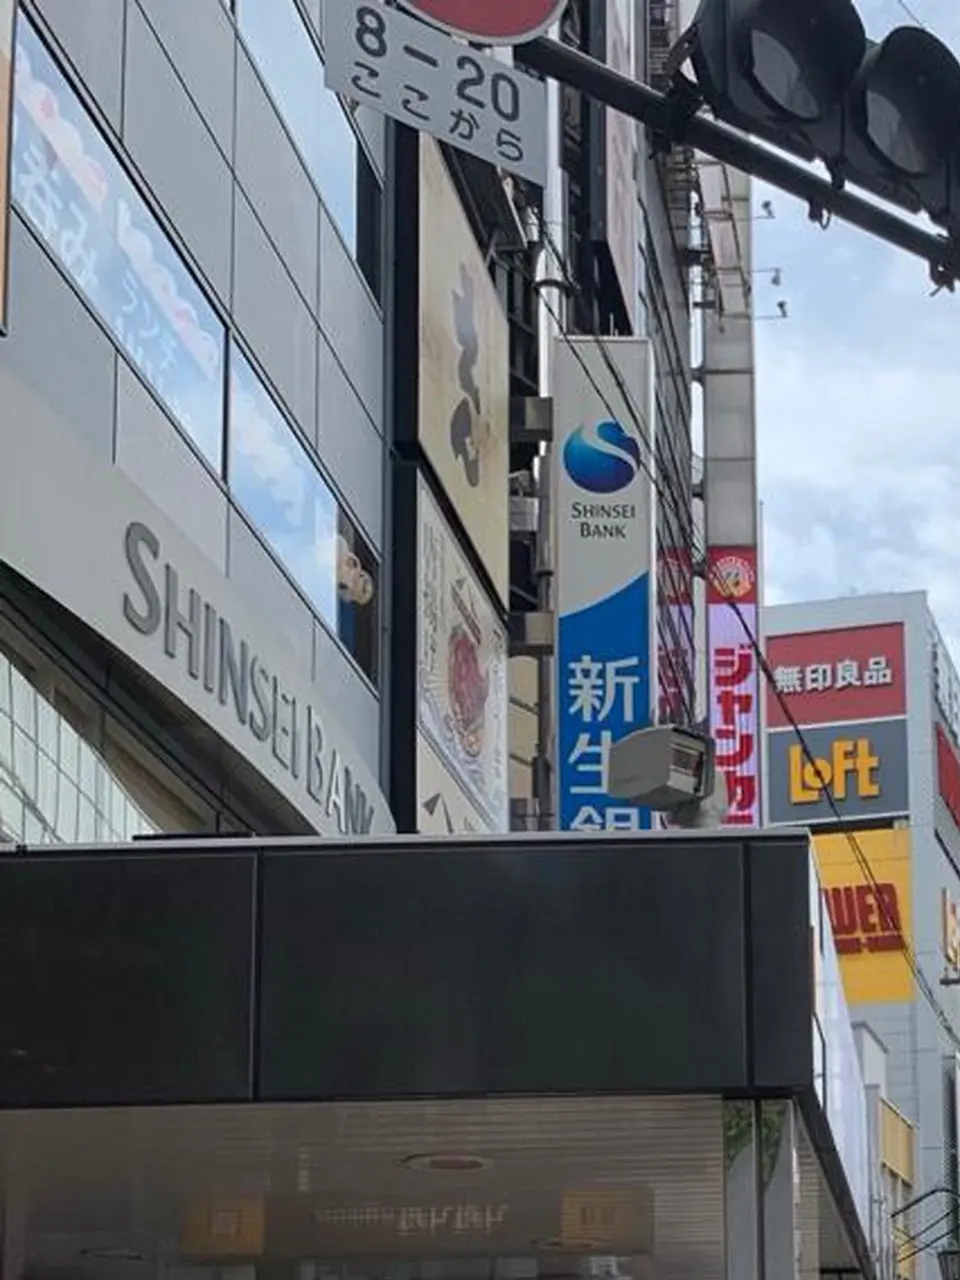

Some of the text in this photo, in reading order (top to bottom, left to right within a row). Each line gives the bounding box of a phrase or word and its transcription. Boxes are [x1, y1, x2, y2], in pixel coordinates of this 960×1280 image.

[351, 61, 524, 163] ここから
[571, 502, 636, 519] SHINSEI
[580, 523, 626, 539] BANK
[123, 522, 299, 780] SHINSEI
[773, 656, 892, 694] 無印良品
[713, 644, 756, 827] ジャンカ
